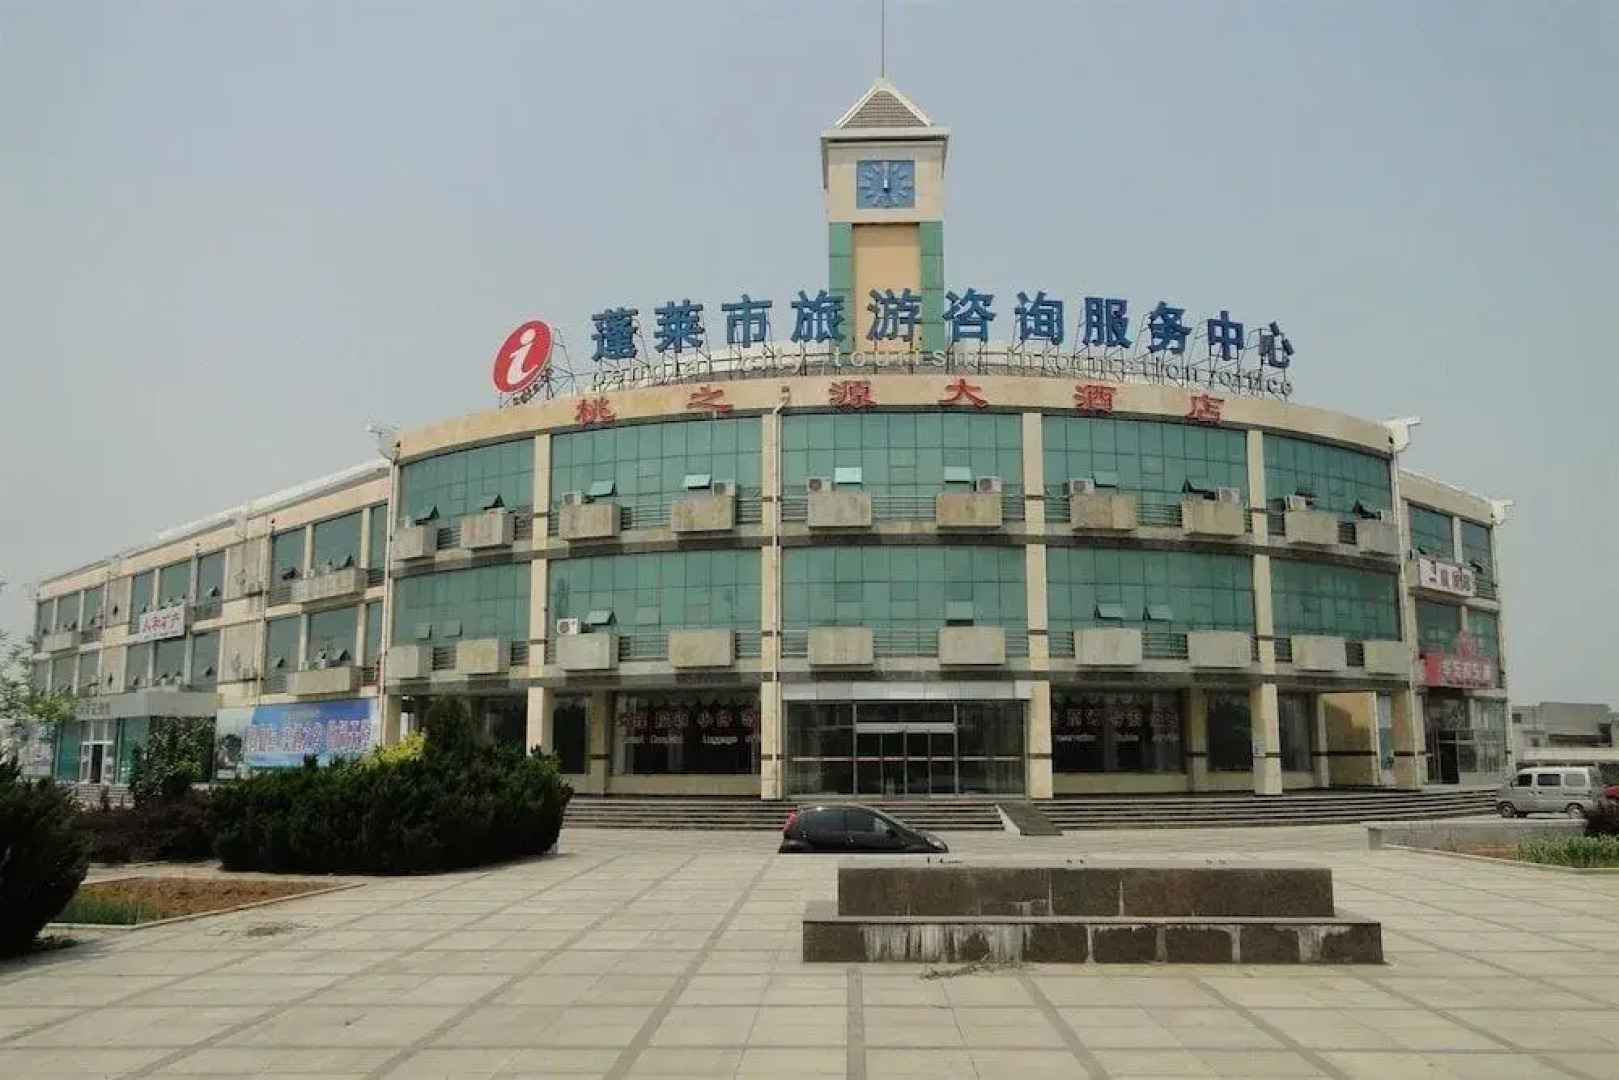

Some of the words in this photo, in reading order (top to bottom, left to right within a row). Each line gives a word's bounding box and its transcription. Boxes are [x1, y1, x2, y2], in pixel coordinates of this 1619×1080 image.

[591, 287, 1295, 369] 蓬莱市旅游咨询服务中心
[575, 378, 1226, 426] 桃之源大酒店
